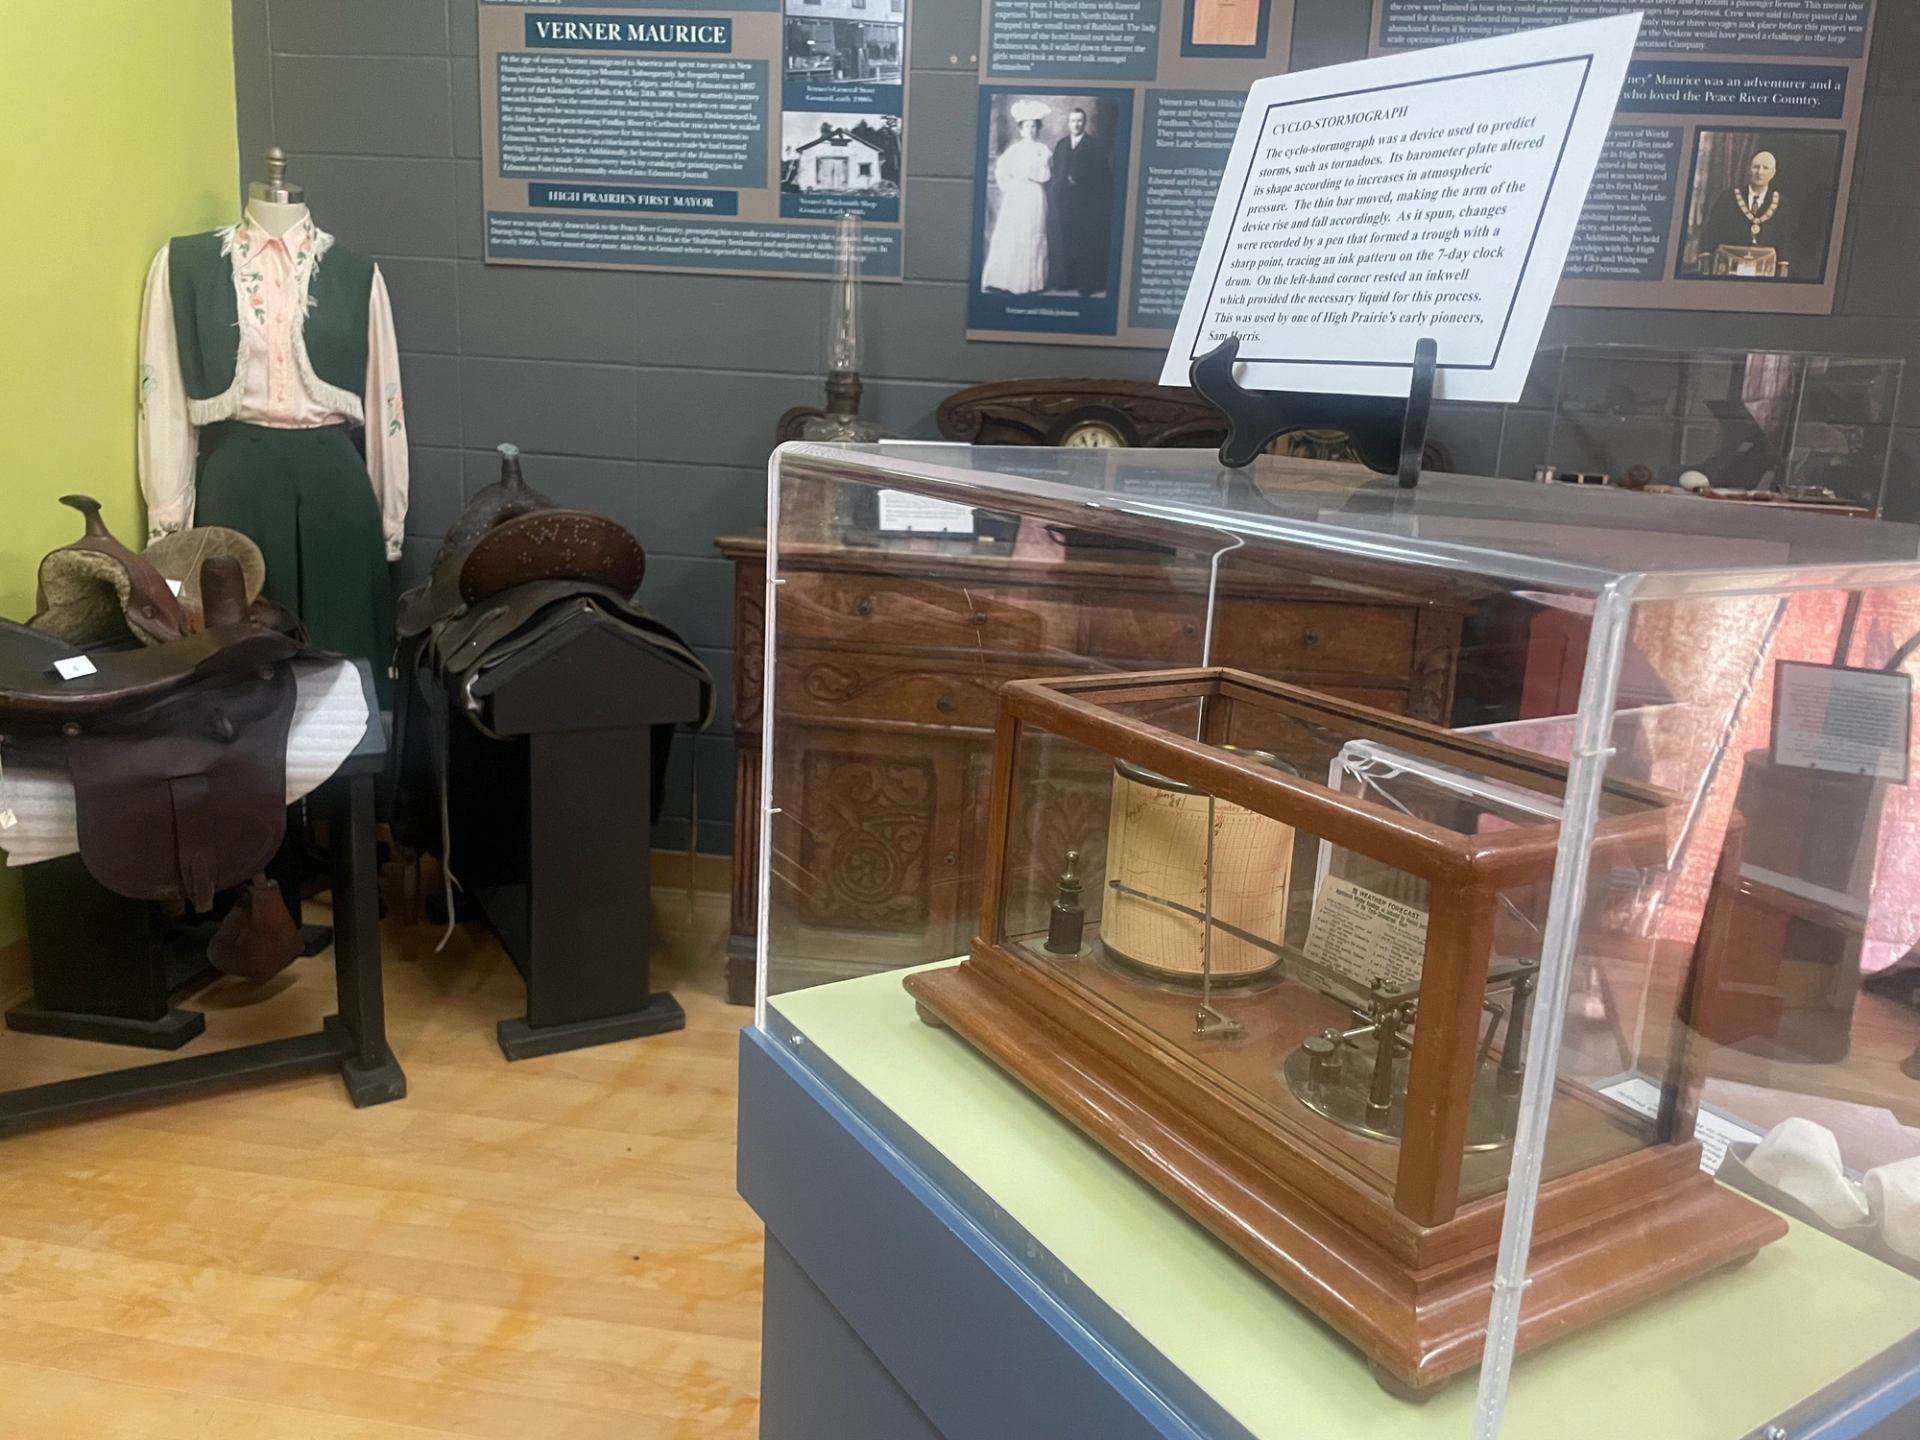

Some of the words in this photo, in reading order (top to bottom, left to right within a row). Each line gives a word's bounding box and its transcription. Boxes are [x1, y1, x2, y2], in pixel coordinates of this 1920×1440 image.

[536, 21, 622, 41] VERNER
[627, 24, 727, 44] MAURICE
[1627, 73, 1653, 87] ney"
[1655, 73, 1701, 86] Maurice
[1704, 77, 1723, 87] was
[1726, 78, 1741, 87] an
[1743, 76, 1806, 89] adventurer
[1809, 79, 1832, 90] and
[1834, 82, 1841, 91] a
[1624, 88, 1646, 100] who
[1649, 89, 1680, 101] loved
[1683, 90, 1701, 101] the
[1705, 91, 1736, 102] Peace
[1740, 92, 1769, 103] River
[1772, 93, 1821, 108] Country.
[1272, 105, 1408, 135] CYCLO-STORMOGRAPH
[1265, 147, 1283, 159] The
[1284, 135, 1375, 159] cyclo-stormograph
[1378, 134, 1398, 144] was
[1399, 133, 1407, 142] a
[1409, 127, 1444, 141] device
[1447, 122, 1475, 136] used
[1476, 122, 1488, 133] to
[1489, 115, 1536, 135] predict
[1258, 166, 1291, 177] storms,
[1293, 160, 1315, 174] such
[1317, 161, 1329, 171] as
[1330, 154, 1382, 169] tornadoes.
[1388, 151, 1403, 163] Its
[1405, 146, 1466, 161] barometer
[1465, 141, 1498, 158] plate
[1499, 135, 1545, 151] altered
[1252, 185, 1264, 196] its
[1265, 183, 1292, 196] shape
[1293, 177, 1342, 191] according
[1343, 177, 1354, 187] to
[1355, 172, 1404, 186] increases
[1406, 169, 1417, 181] in
[1419, 161, 1492, 180] atmospheric
[548, 190, 580, 202] HIGH
[637, 194, 671, 206] FIRST
[673, 196, 714, 208] MAYOR
[1245, 202, 1287, 217] pressure.
[1294, 198, 1312, 210] The
[1313, 196, 1333, 208] thin
[1335, 195, 1355, 207] bar
[1355, 190, 1393, 208] moved,
[1395, 187, 1439, 202] making
[1440, 185, 1459, 198] the
[1461, 185, 1487, 196] arm
[1489, 180, 1505, 194] of
[1505, 180, 1525, 193] the
[1241, 220, 1270, 232] device
[1271, 218, 1289, 230] rise
[1290, 216, 1310, 229] and
[1310, 215, 1329, 227] fall
[1328, 210, 1390, 226] accordingly.
[1395, 210, 1412, 222] As
[1412, 208, 1423, 220] it
[1423, 209, 1455, 223] spun,
[1458, 204, 1507, 219] changes
[1236, 241, 1258, 250] were
[1258, 235, 1301, 249] recorded
[1302, 235, 1315, 249] by
[1316, 237, 1323, 246] a
[1323, 236, 1344, 248] pen
[1346, 232, 1368, 244] that
[1368, 229, 1410, 243] formed
[1410, 231, 1418, 240] a
[1421, 226, 1459, 242] trough
[1463, 224, 1489, 238] with
[1492, 227, 1500, 236] a
[1229, 257, 1256, 271] sharp
[1256, 255, 1283, 271] point,
[1285, 254, 1321, 268] tracing
[1322, 255, 1335, 264] an
[1337, 252, 1355, 264] ink
[1355, 252, 1396, 267] pattern
[1398, 252, 1412, 262] on
[1415, 248, 1434, 261] the
[1437, 247, 1470, 262] 7-day
[1472, 245, 1504, 259] clock
[1224, 275, 1251, 286] drum.
[1256, 274, 1271, 286] On
[1273, 273, 1288, 285] the
[1289, 272, 1335, 285] left-hand
[1336, 273, 1372, 283] corner
[1372, 269, 1407, 283] rested
[1407, 272, 1422, 281] an
[1425, 267, 1469, 281] inkwell
[1219, 293, 1245, 304] which
[1245, 292, 1289, 307] provided
[1290, 292, 1306, 304] the
[1307, 294, 1356, 306] necessary
[1357, 290, 1390, 306] liquid
[1391, 290, 1410, 303] for
[1411, 289, 1432, 302] this
[1433, 292, 1481, 305] process.
[1214, 311, 1233, 323] This
[1235, 314, 1252, 323] was
[1253, 311, 1276, 323] used
[1276, 311, 1289, 325] by
[1290, 314, 1308, 322] one
[1310, 311, 1323, 322] of
[1322, 311, 1348, 325] High
[1349, 311, 1397, 323] Prairie's
[1398, 311, 1428, 326] early
[1428, 310, 1483, 326] pioneers,
[1208, 330, 1228, 341] Sam
[1388, 902, 1421, 920] FORECAST
